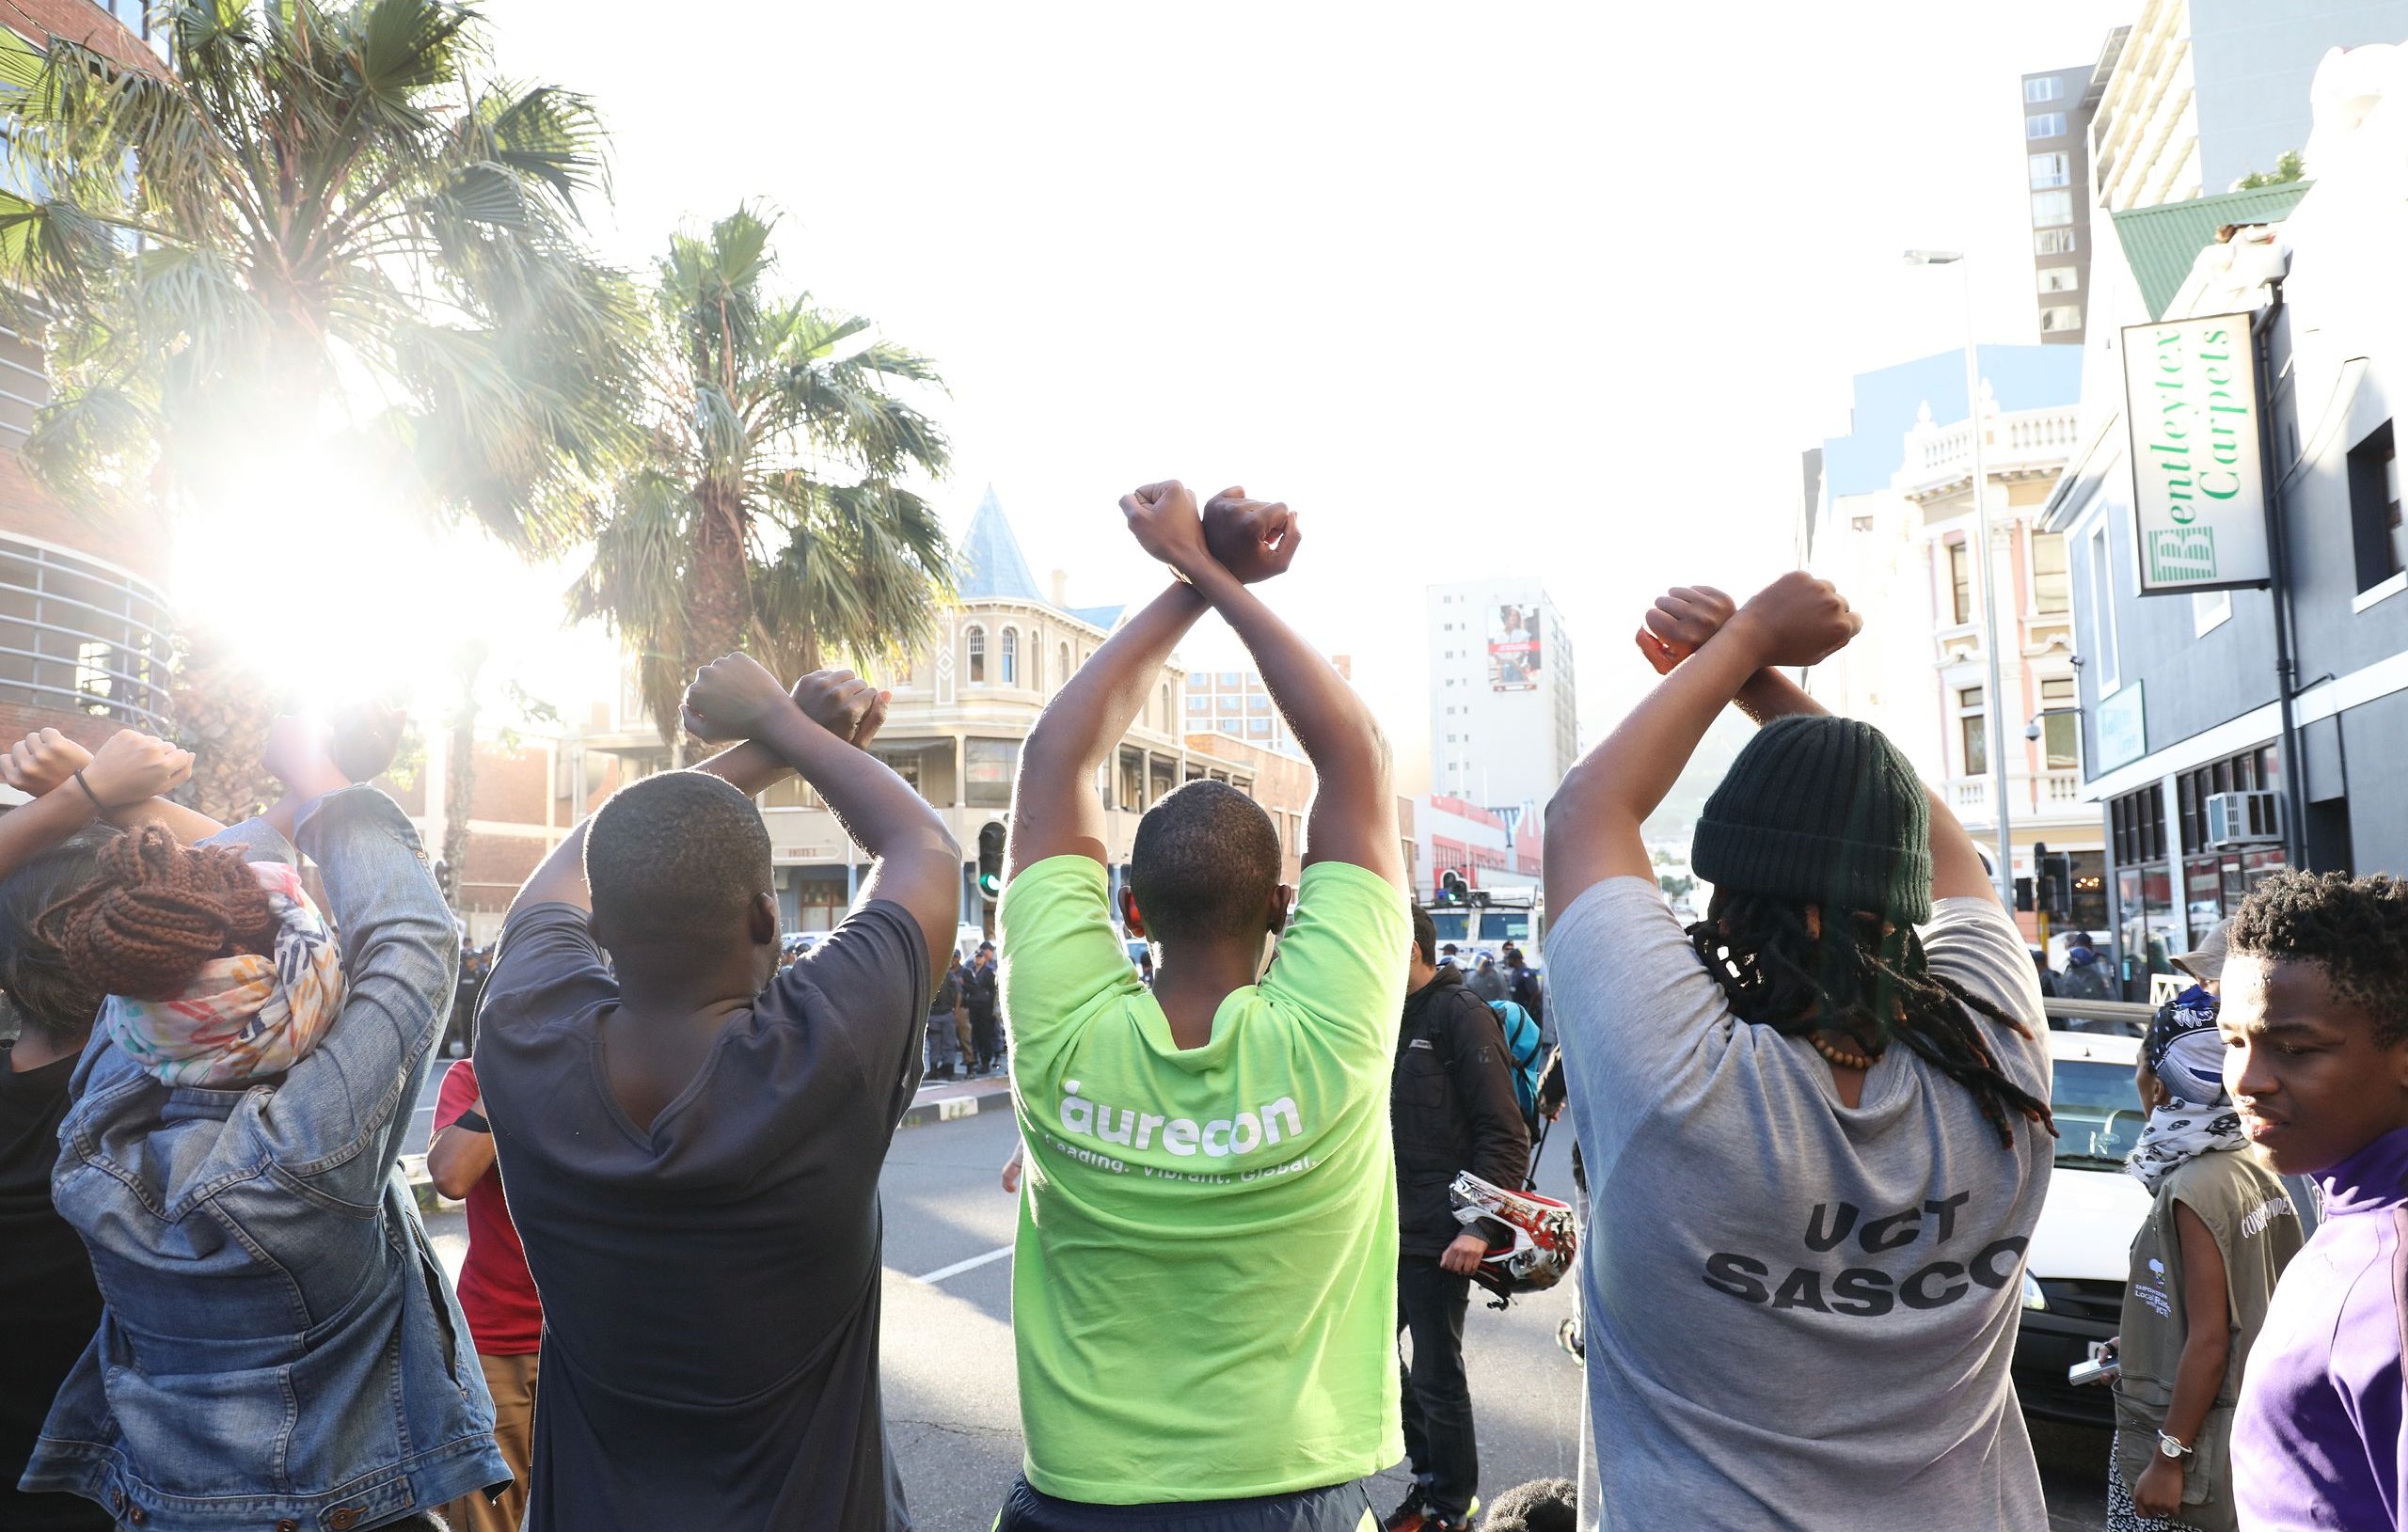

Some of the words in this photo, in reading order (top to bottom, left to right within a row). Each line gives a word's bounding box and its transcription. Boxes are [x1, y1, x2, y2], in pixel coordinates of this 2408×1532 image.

[2195, 329, 2248, 500] Carpets
[2148, 330, 2218, 582] Bentleytex
[788, 847, 816, 858] HOTEL
[1045, 1133, 1130, 1174] eading.
[1804, 1190, 1970, 1255] UCT
[1702, 1235, 2031, 1318] SASCO
